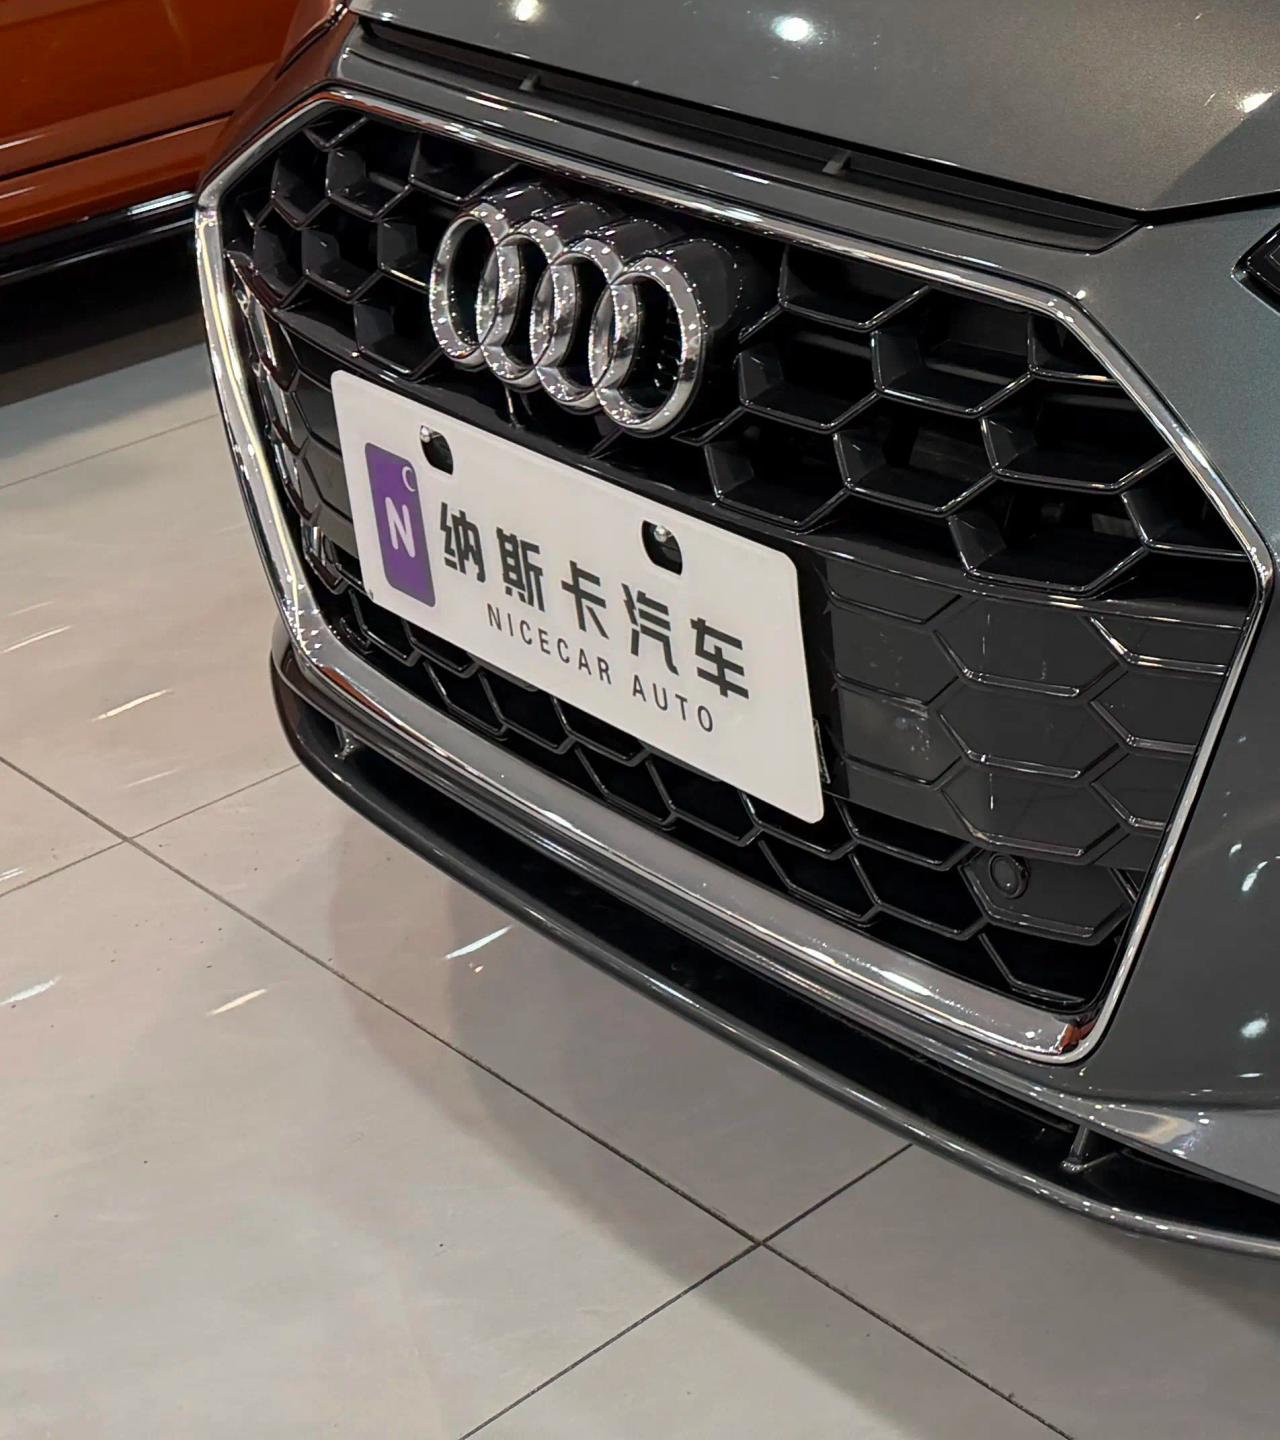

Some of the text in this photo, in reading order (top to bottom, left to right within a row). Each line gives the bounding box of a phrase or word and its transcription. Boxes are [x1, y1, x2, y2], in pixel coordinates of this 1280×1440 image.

[385, 496, 416, 559] N
[440, 501, 750, 700] 纳斯卡汽车
[486, 602, 714, 733] NICECAR AUTO
